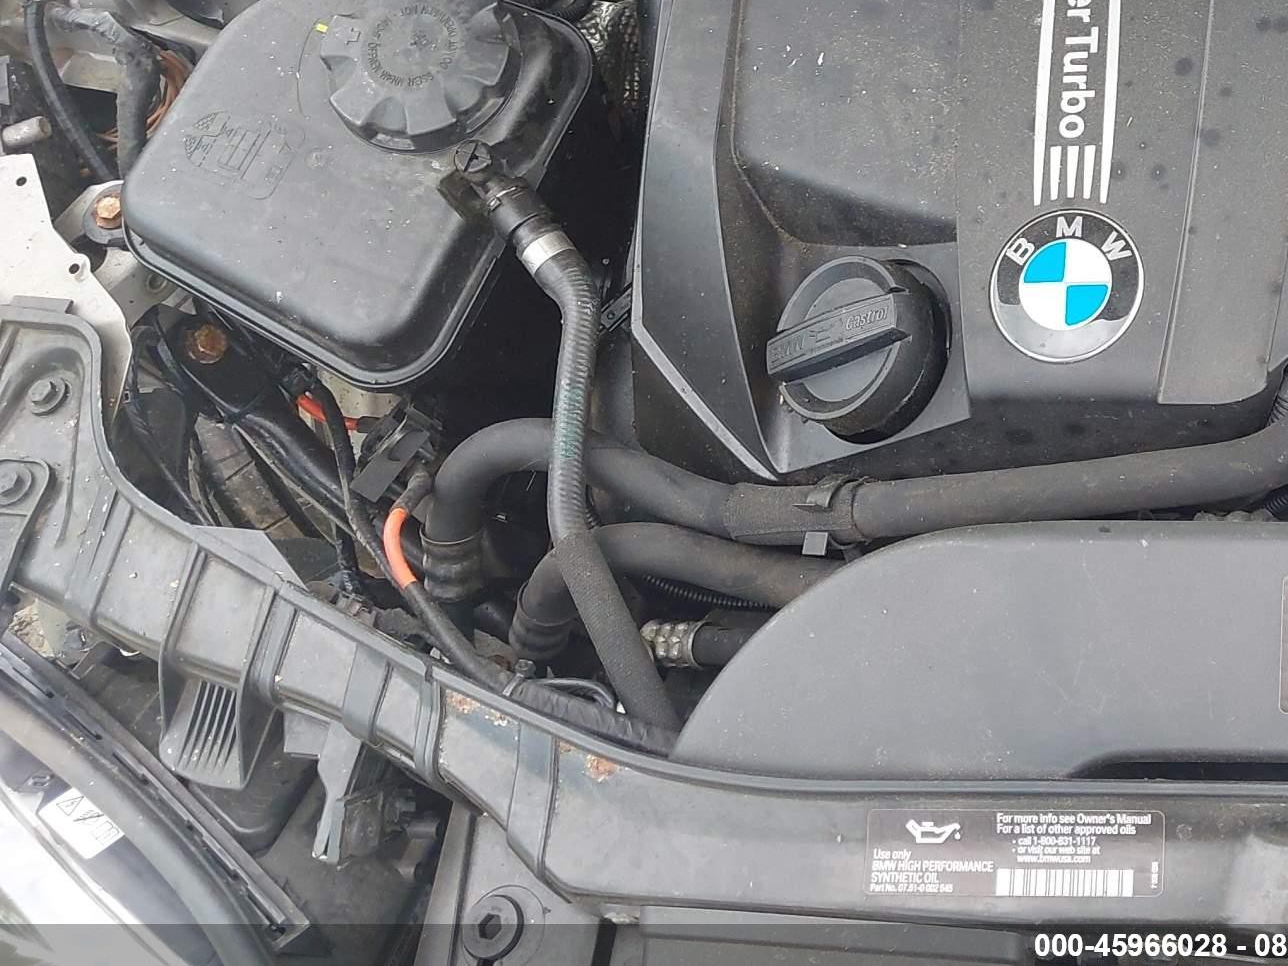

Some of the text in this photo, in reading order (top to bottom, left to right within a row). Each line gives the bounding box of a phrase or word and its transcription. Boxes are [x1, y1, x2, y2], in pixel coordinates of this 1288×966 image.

[1059, 26, 1099, 139] Turbo
[1005, 215, 1133, 266] BMW
[845, 305, 889, 331] Castrol
[996, 813, 1151, 825] For more info see Owner's Manual
[996, 824, 1013, 834] For
[1022, 824, 1036, 834] list
[1037, 824, 1046, 834] of
[1048, 824, 1073, 835] other
[1074, 825, 1118, 836] approved
[1120, 825, 1136, 835] oils
[1018, 837, 1032, 846] call
[873, 849, 912, 862] Use only
[1017, 847, 1027, 855] or
[1076, 846, 1091, 855] site
[1092, 847, 1101, 855] at
[872, 860, 994, 872] BMW HIGH PERFORMANCE
[871, 872, 940, 884] SYNTHETIC OIL
